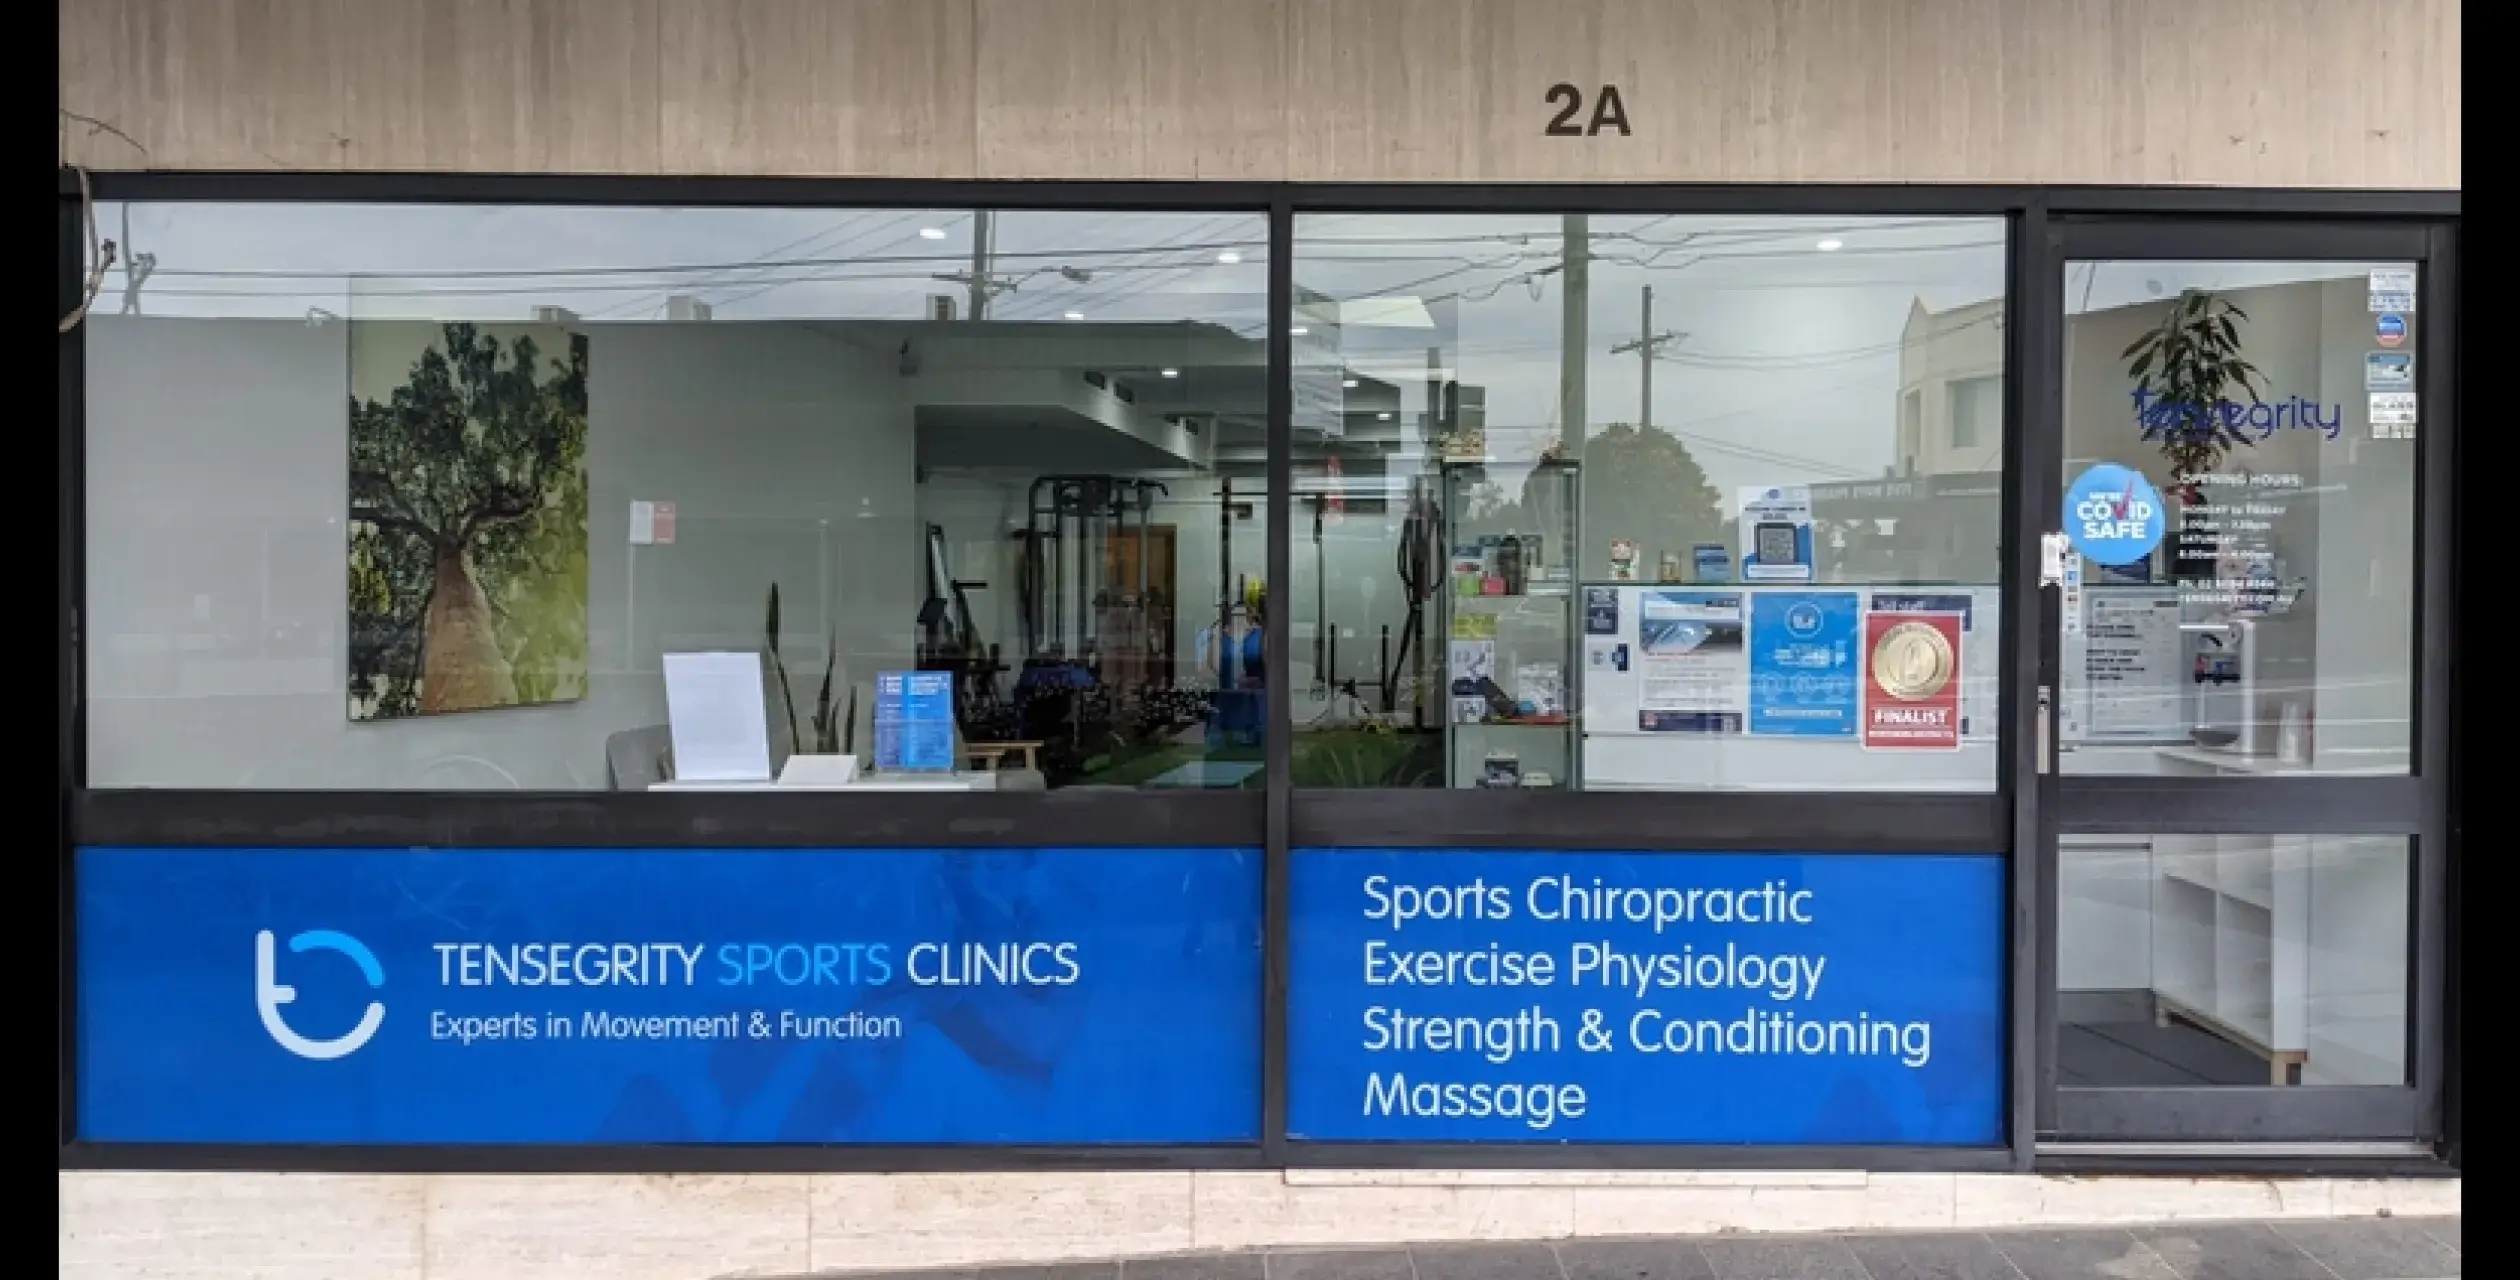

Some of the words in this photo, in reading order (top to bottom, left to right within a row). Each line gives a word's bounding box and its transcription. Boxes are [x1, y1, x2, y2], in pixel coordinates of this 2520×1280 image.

[1545, 83, 1631, 136] 2A
[2131, 388, 2341, 440] tegrity
[2077, 497, 2152, 521] COVID
[2084, 522, 2147, 539] SAFE
[1874, 708, 1948, 725] FINALIST
[1363, 875, 1511, 931] Sports
[1527, 875, 1814, 933] Chiropractic
[432, 943, 705, 986] TENSEGRITY
[718, 943, 891, 986] SPORTS
[907, 942, 1081, 986] CLINICS
[1365, 941, 1556, 987] Exercise
[1572, 940, 1827, 1001] Physiology
[431, 1011, 537, 1046] Experts
[547, 1011, 573, 1038] in
[580, 1011, 740, 1039] Movement
[747, 1012, 773, 1038] &
[780, 1011, 901, 1039] Function
[1363, 1006, 1560, 1064] Strength
[1577, 1009, 1613, 1052] &
[1629, 1008, 1931, 1068] Conditioning
[1363, 1072, 1587, 1129] Massage
